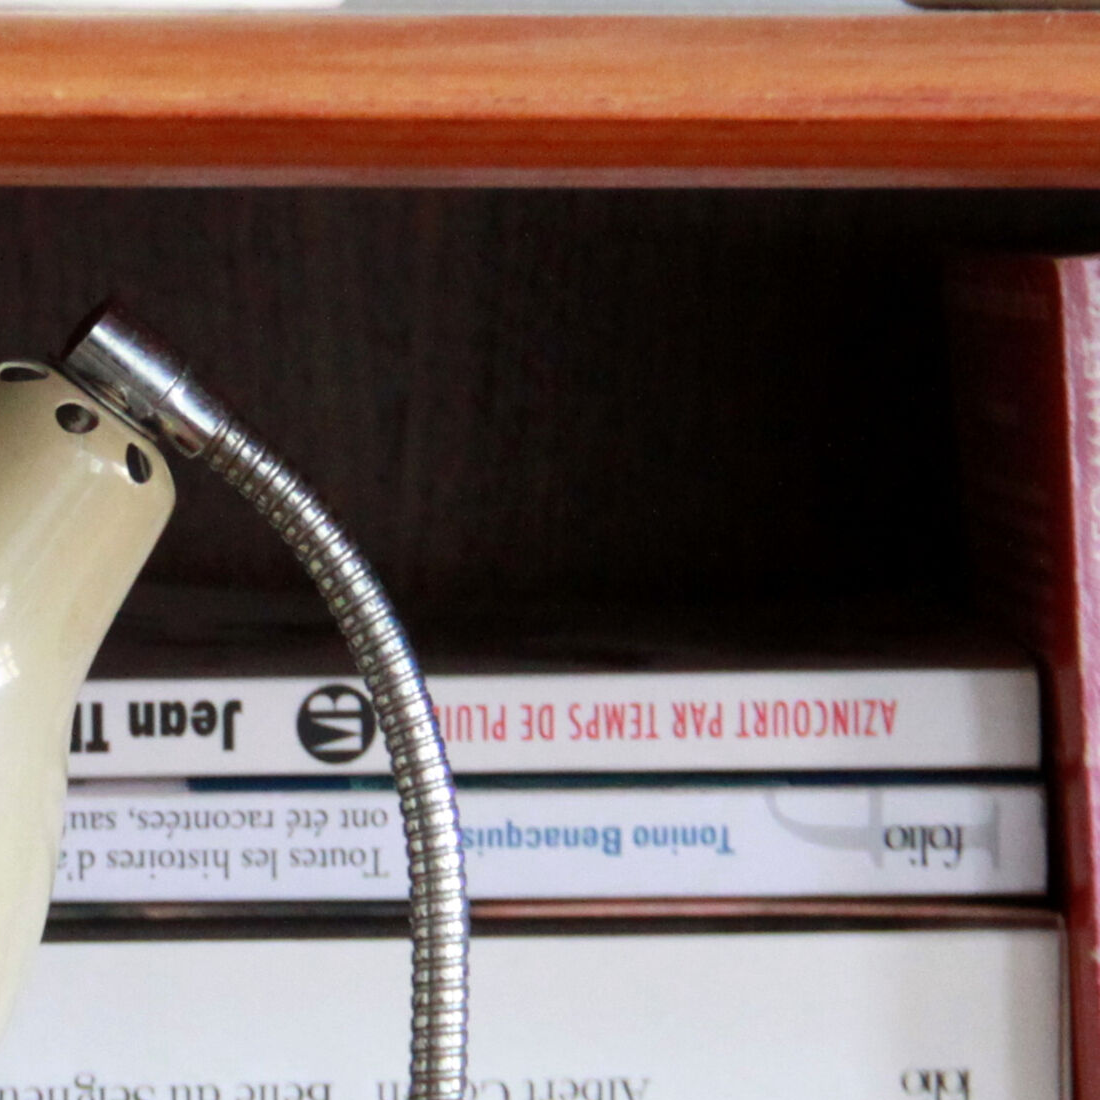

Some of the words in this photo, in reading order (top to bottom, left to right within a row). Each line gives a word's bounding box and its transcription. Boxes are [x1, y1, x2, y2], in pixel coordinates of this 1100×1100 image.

[129, 700, 243, 753] Jean
[429, 706, 507, 744] PLUI
[520, 706, 555, 741] DE
[568, 703, 657, 741] TEMPS
[672, 701, 722, 740] PAR
[738, 699, 897, 738] AZINCOURT
[62, 810, 118, 837] sau
[128, 808, 275, 838] racontées,
[286, 809, 328, 839] été
[339, 808, 389, 830] ont
[632, 824, 734, 855] Tonino
[884, 824, 964, 869] folio
[106, 848, 230, 881] histoires
[241, 848, 278, 881] les
[290, 847, 389, 879] Toutes
